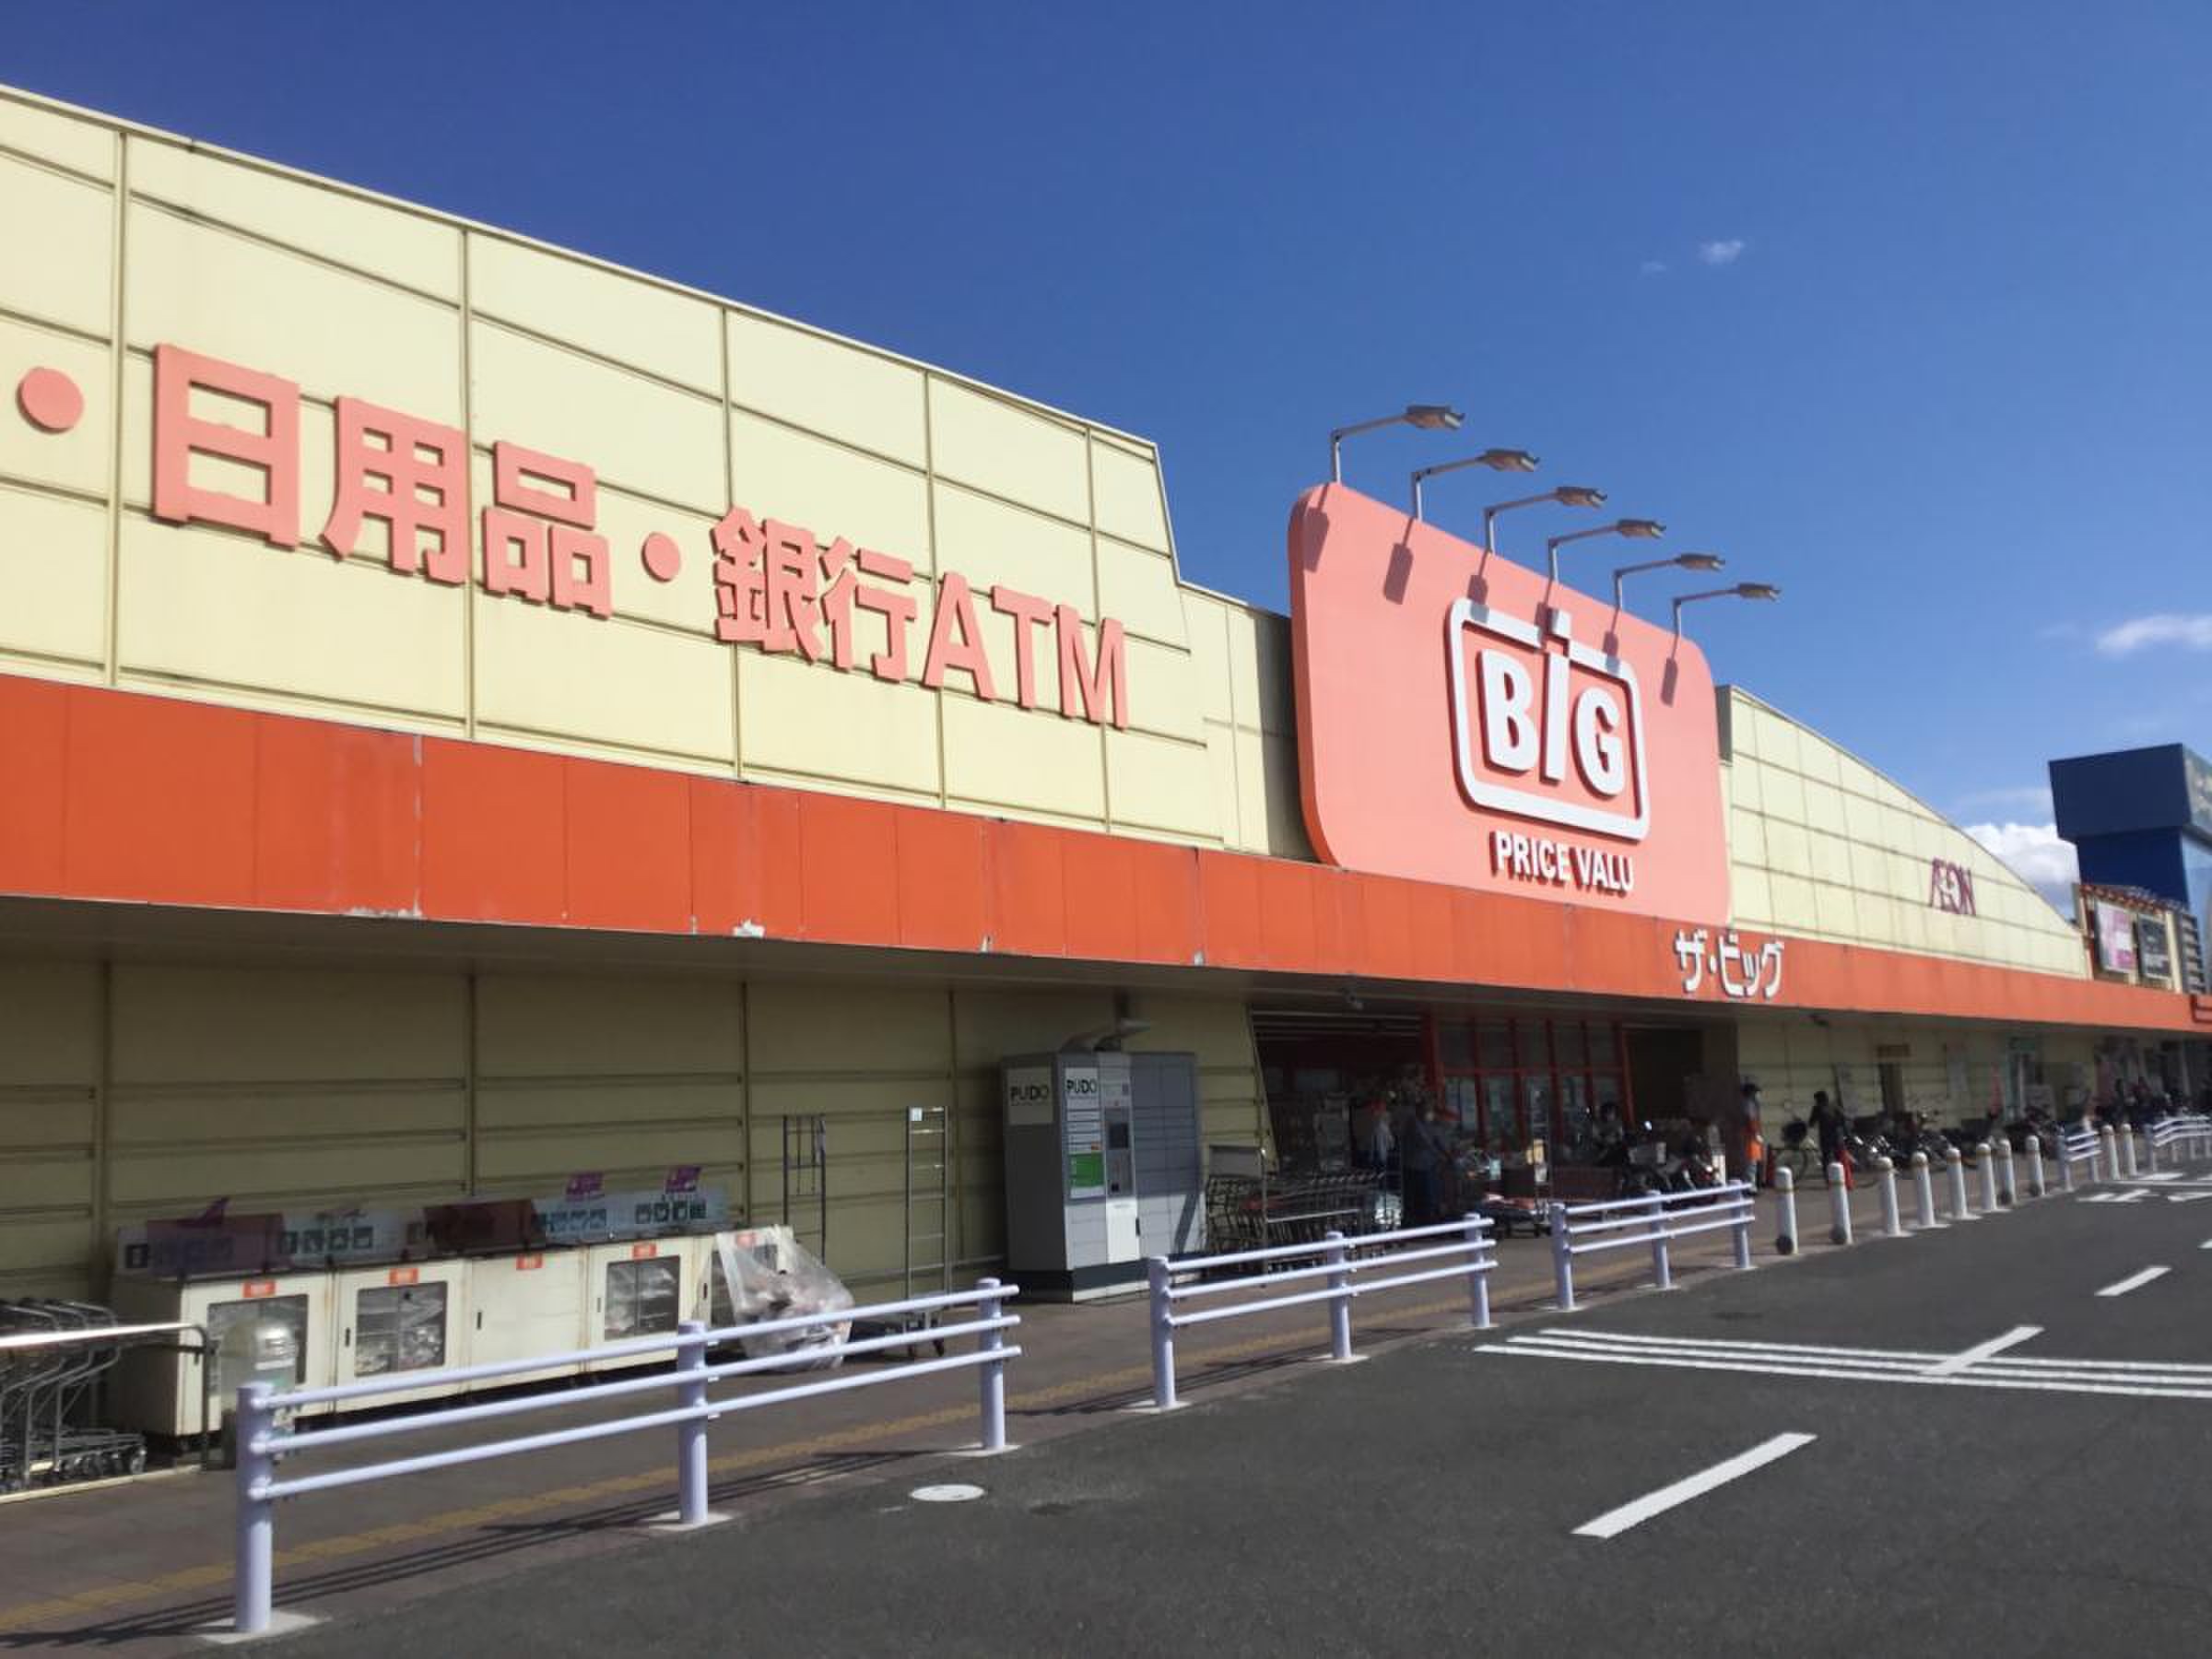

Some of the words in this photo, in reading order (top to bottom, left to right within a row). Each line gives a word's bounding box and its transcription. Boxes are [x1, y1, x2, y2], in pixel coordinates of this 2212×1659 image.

[1477, 607, 1627, 797] BIG
[1492, 830, 1571, 883] PRICE
[1577, 847, 1634, 895] VALU
[1010, 1084, 1049, 1101] PUDO
[1065, 1078, 1098, 1095] PUDO
